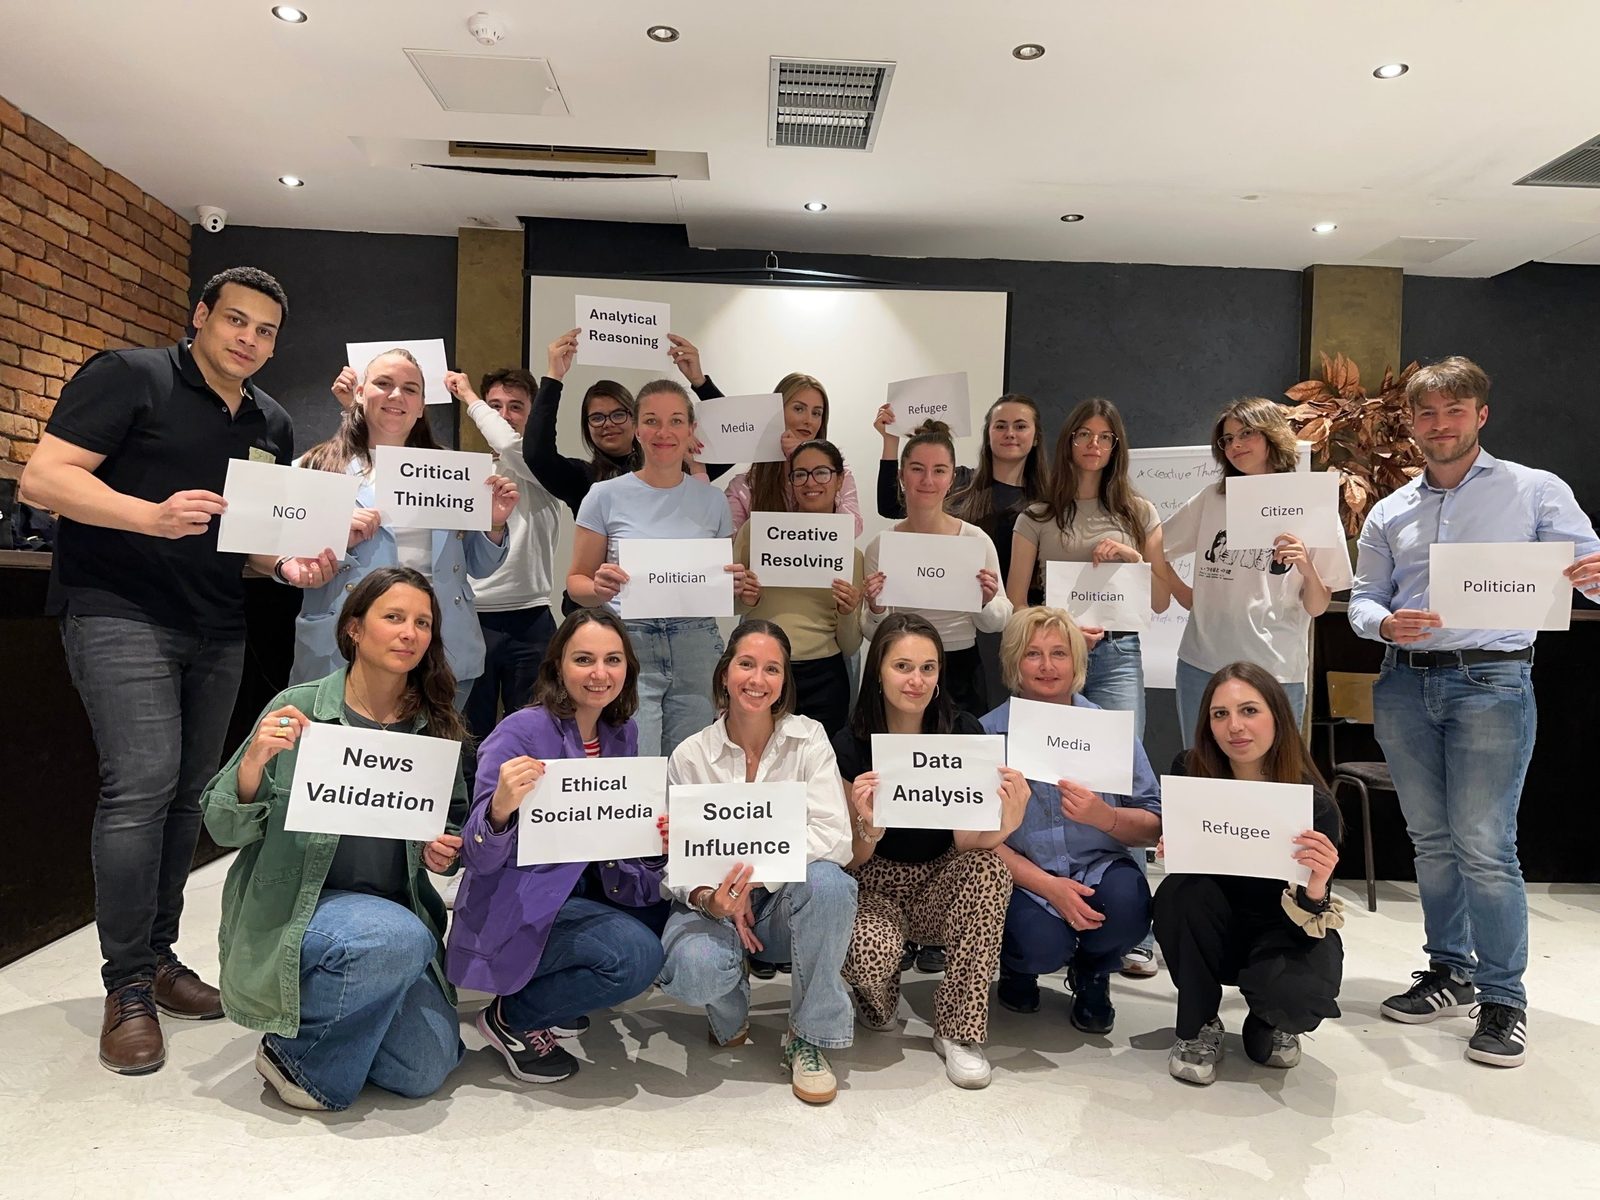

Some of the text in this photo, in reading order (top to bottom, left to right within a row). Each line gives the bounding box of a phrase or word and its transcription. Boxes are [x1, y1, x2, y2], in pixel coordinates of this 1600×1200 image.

[589, 308, 658, 326] Analytical
[589, 328, 659, 350] Reasoning
[908, 403, 948, 415] Refugee
[721, 421, 755, 434] Media
[399, 462, 471, 482] Critical
[393, 490, 475, 513] Thinking
[272, 505, 307, 521] NGO
[1260, 506, 1304, 518] Citizen
[766, 526, 838, 542] Creative
[760, 552, 844, 572] Resolving
[648, 571, 706, 584] Politician
[917, 566, 946, 579] NGO
[1463, 579, 1536, 593] Politician
[1070, 590, 1125, 602] Politician
[1046, 735, 1091, 752] Media
[342, 746, 414, 773] News
[912, 751, 963, 770] Data
[561, 775, 628, 793] Ethical
[306, 781, 435, 813] Validation
[892, 784, 984, 807] Analysis
[530, 803, 653, 824] Social Media
[703, 800, 773, 821] Social
[1202, 819, 1271, 840] Refugee
[684, 838, 791, 858] Influence
